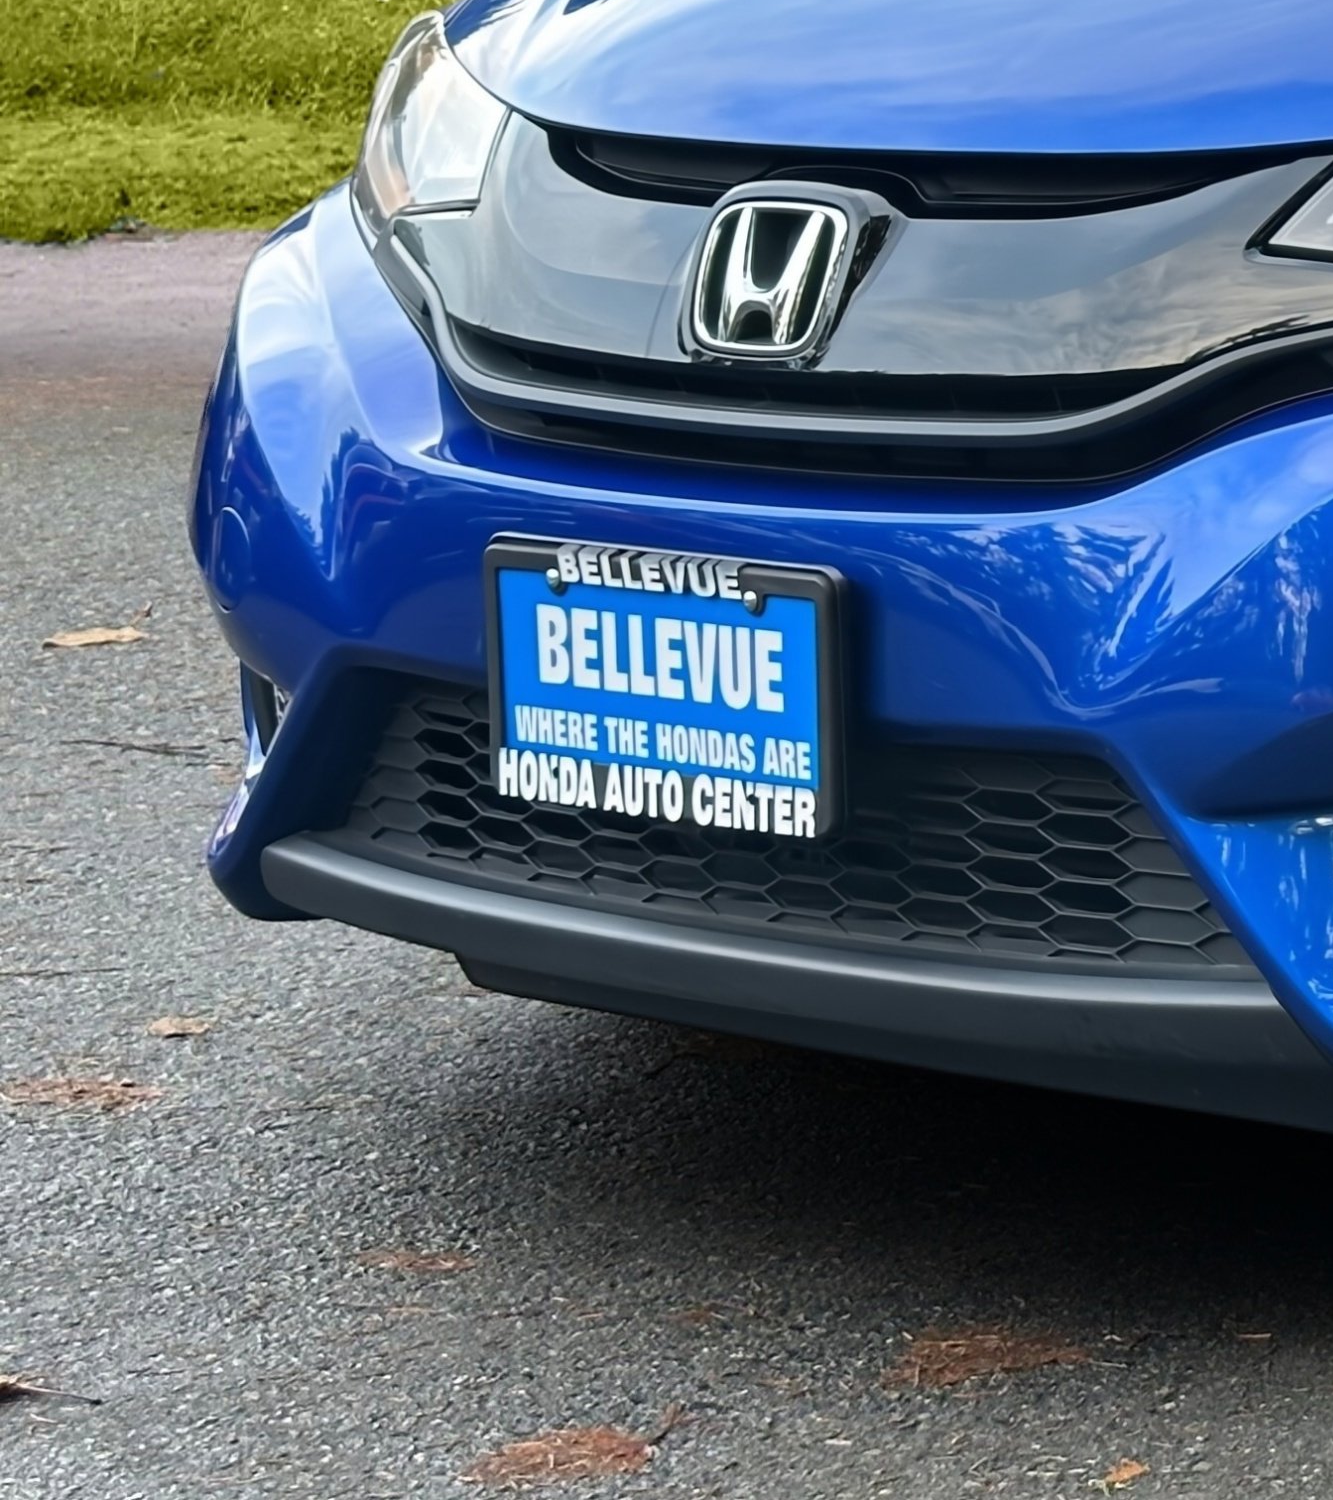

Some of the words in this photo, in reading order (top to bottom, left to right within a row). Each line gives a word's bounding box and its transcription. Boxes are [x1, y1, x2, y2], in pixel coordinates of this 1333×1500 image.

[557, 550, 742, 599] BELLEVUE
[536, 604, 784, 713] BELLEVUE
[515, 705, 598, 751] WHERE
[604, 717, 649, 758] THE
[656, 723, 756, 773] HONDAS
[763, 737, 812, 780] ARE
[499, 747, 596, 809] HONDA
[603, 763, 684, 822] AUTO
[692, 774, 816, 838] CENTER
